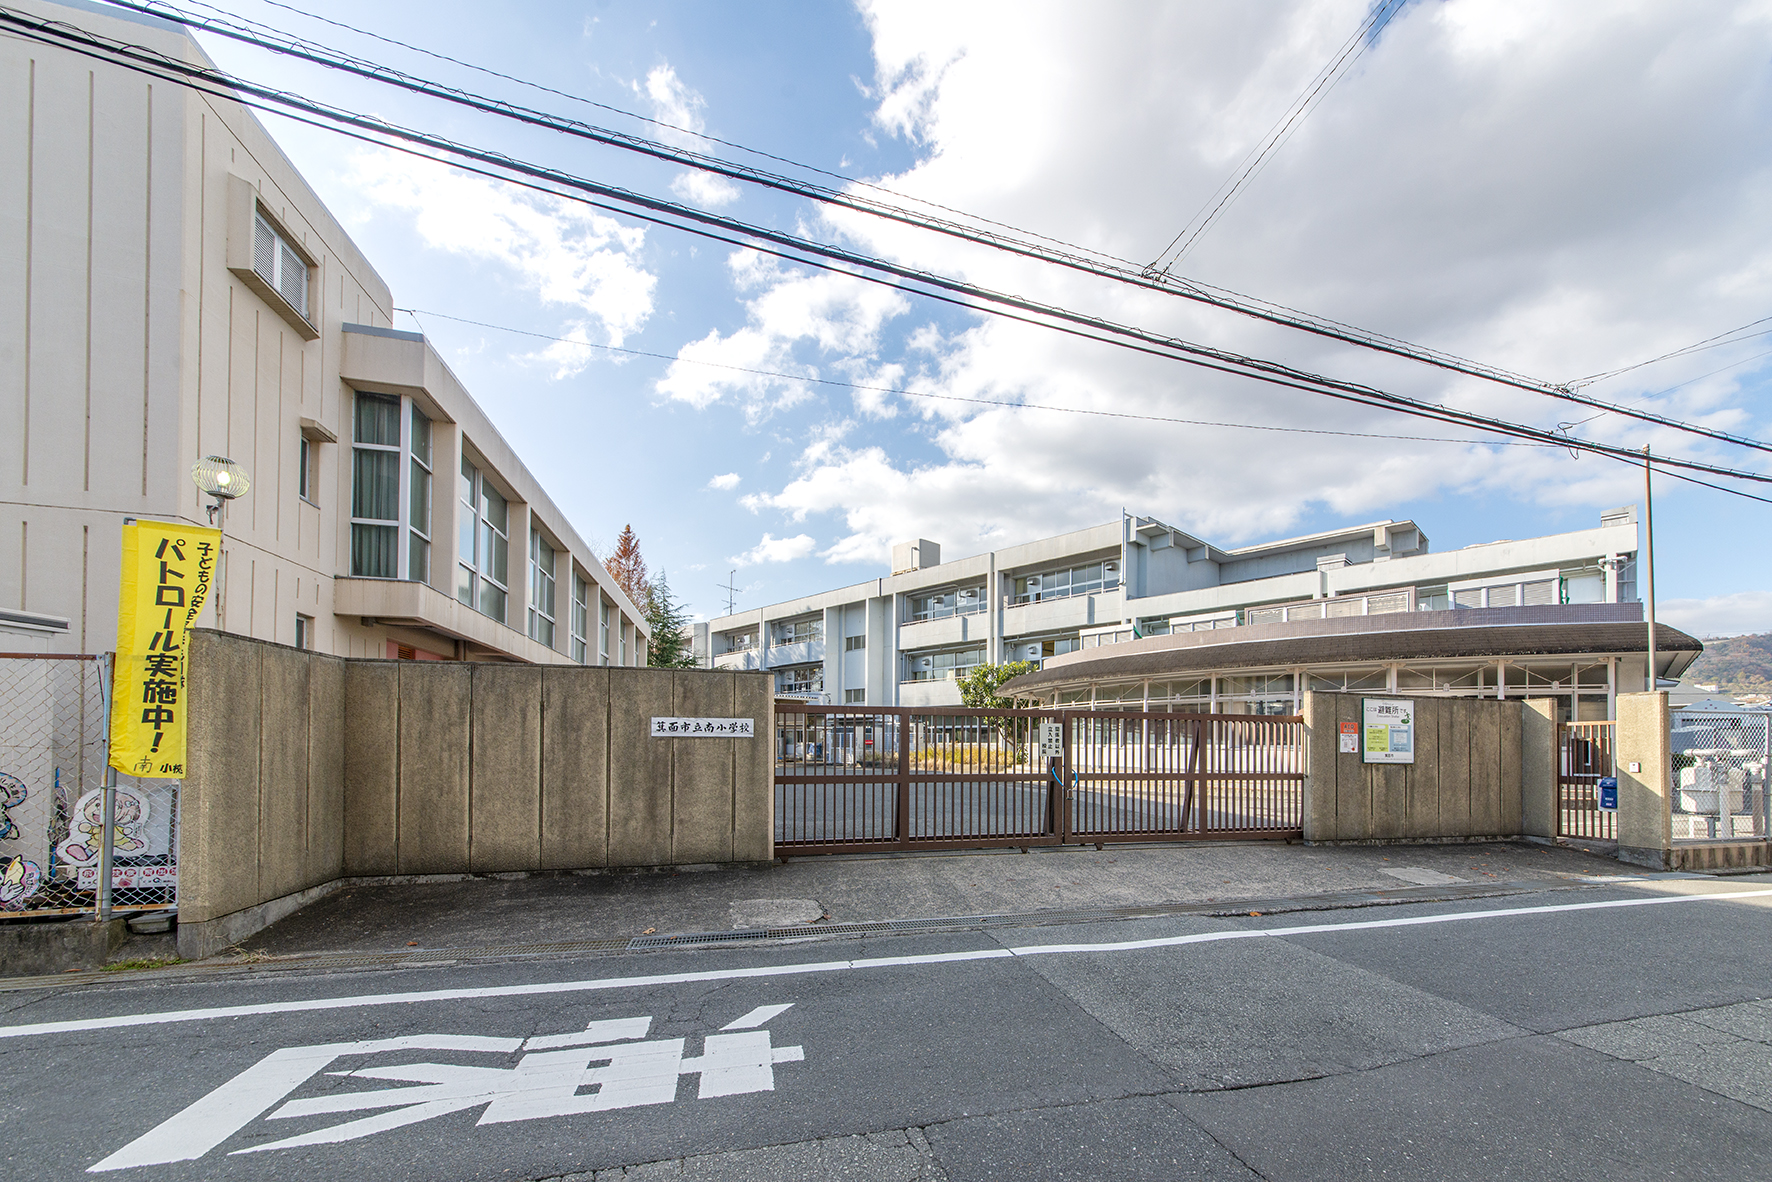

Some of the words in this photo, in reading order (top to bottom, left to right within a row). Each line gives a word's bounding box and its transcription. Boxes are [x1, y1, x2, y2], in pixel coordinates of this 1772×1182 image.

[140, 537, 187, 754] パトロール実施中！
[656, 721, 750, 734] 箕面市立南小学校
[84, 1002, 805, 1173] 速
